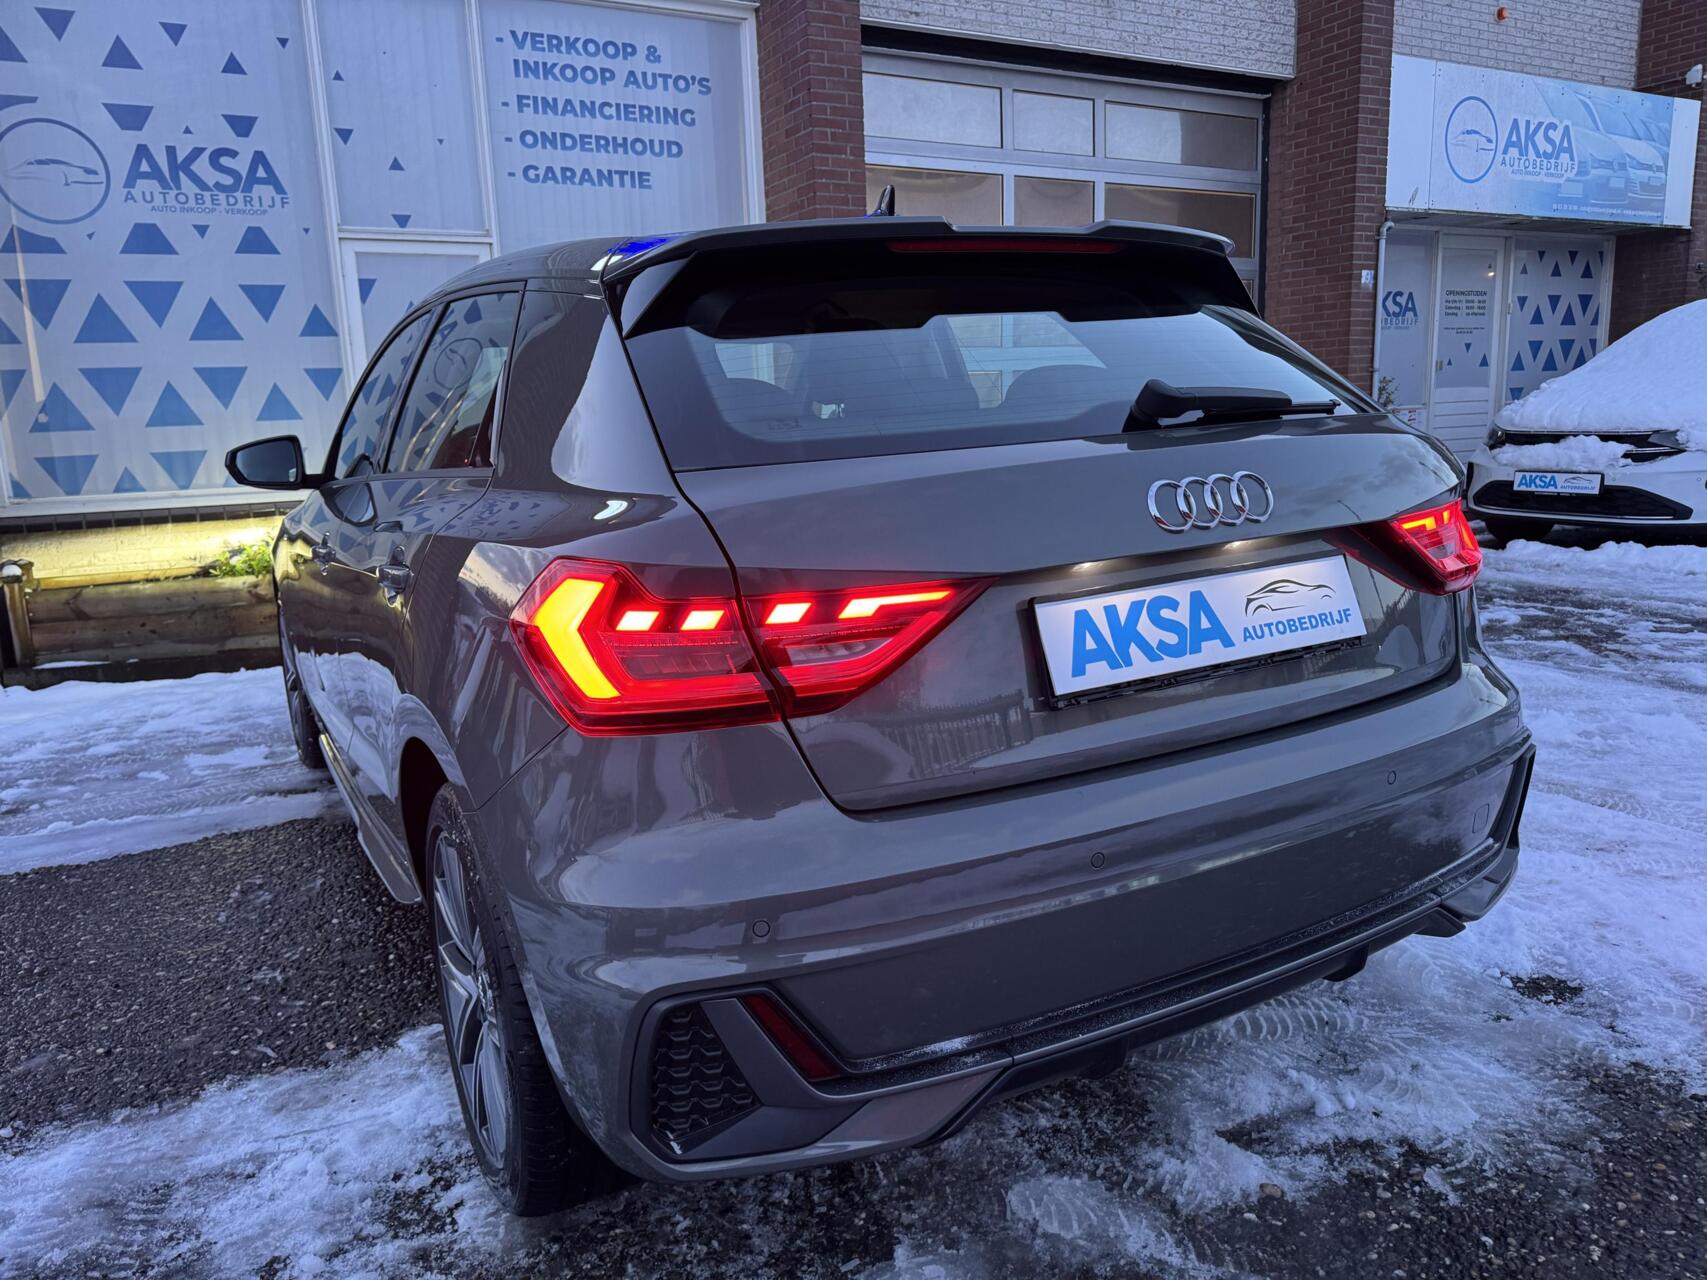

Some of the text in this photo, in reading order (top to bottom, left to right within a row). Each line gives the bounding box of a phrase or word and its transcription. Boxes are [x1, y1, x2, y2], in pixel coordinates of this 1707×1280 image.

[509, 29, 638, 61] VERKOOP
[645, 45, 662, 64] &
[513, 58, 712, 96] INKOOP AUTO'S
[516, 94, 696, 127] FINANCIERING
[519, 129, 683, 158] ONDERHOUD
[1502, 118, 1576, 162] AKSA
[122, 143, 288, 196] AKSA
[522, 164, 652, 190] GARANTIE
[1500, 156, 1576, 173] AUTOBEDRIJF
[123, 190, 290, 209] AUTOBEDRIJF
[150, 205, 177, 213] AUTO
[179, 206, 217, 215] INKOOP
[224, 207, 268, 216] VERKOOP
[1381, 290, 1418, 317] KSA
[1517, 474, 1558, 489] AKSA
[1071, 590, 1352, 678] AKSA AUTOBEDRIJF
